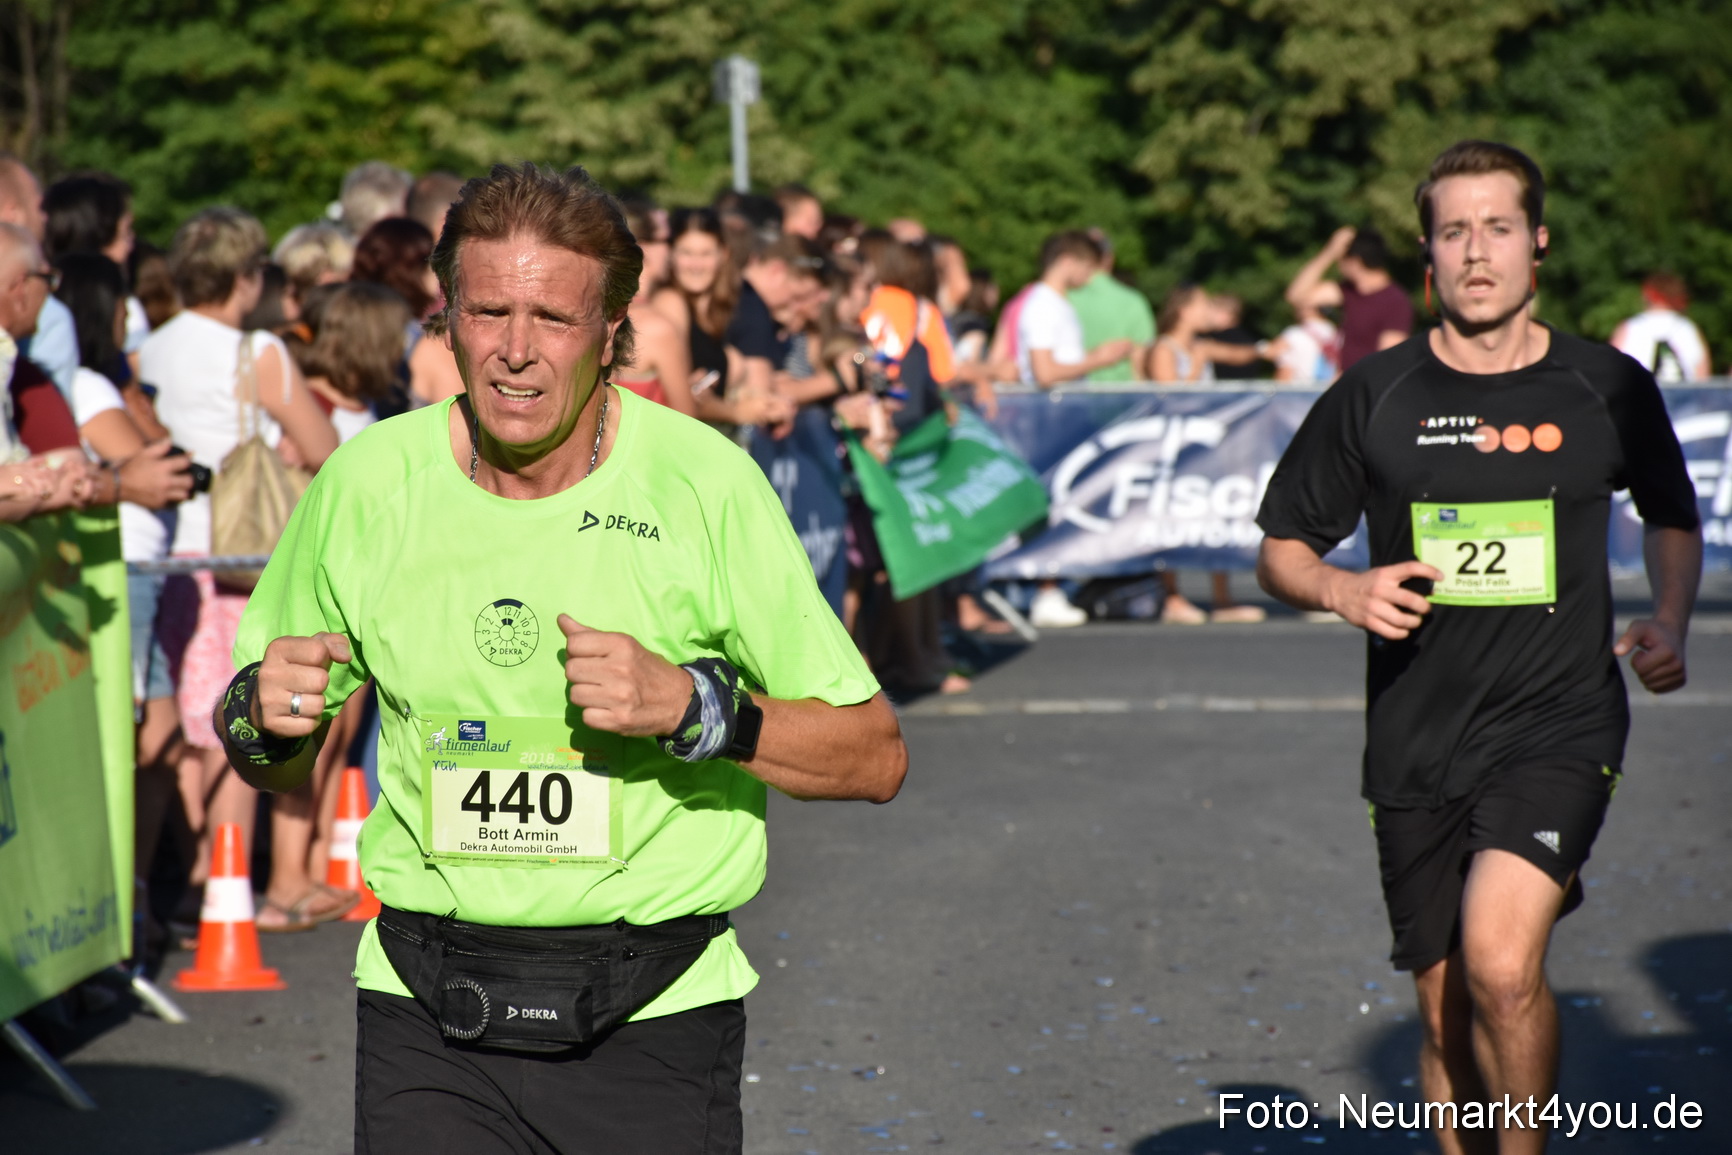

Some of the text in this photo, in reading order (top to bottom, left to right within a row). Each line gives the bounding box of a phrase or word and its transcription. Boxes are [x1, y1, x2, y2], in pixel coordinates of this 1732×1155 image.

[1427, 416, 1477, 428] APTIV
[1417, 433, 1487, 445] Running Team
[605, 515, 661, 542] DEKRA
[1456, 541, 1507, 575] 22
[504, 606, 512, 616] 12
[499, 648, 523, 656] DEKRA
[446, 738, 512, 753] firmenlauf
[519, 752, 555, 764] 2018
[460, 770, 573, 826] 440
[478, 827, 559, 842] Bott Armin
[460, 842, 578, 854] Dekra Automobil GmbH
[521, 1009, 558, 1020] DEKRA
